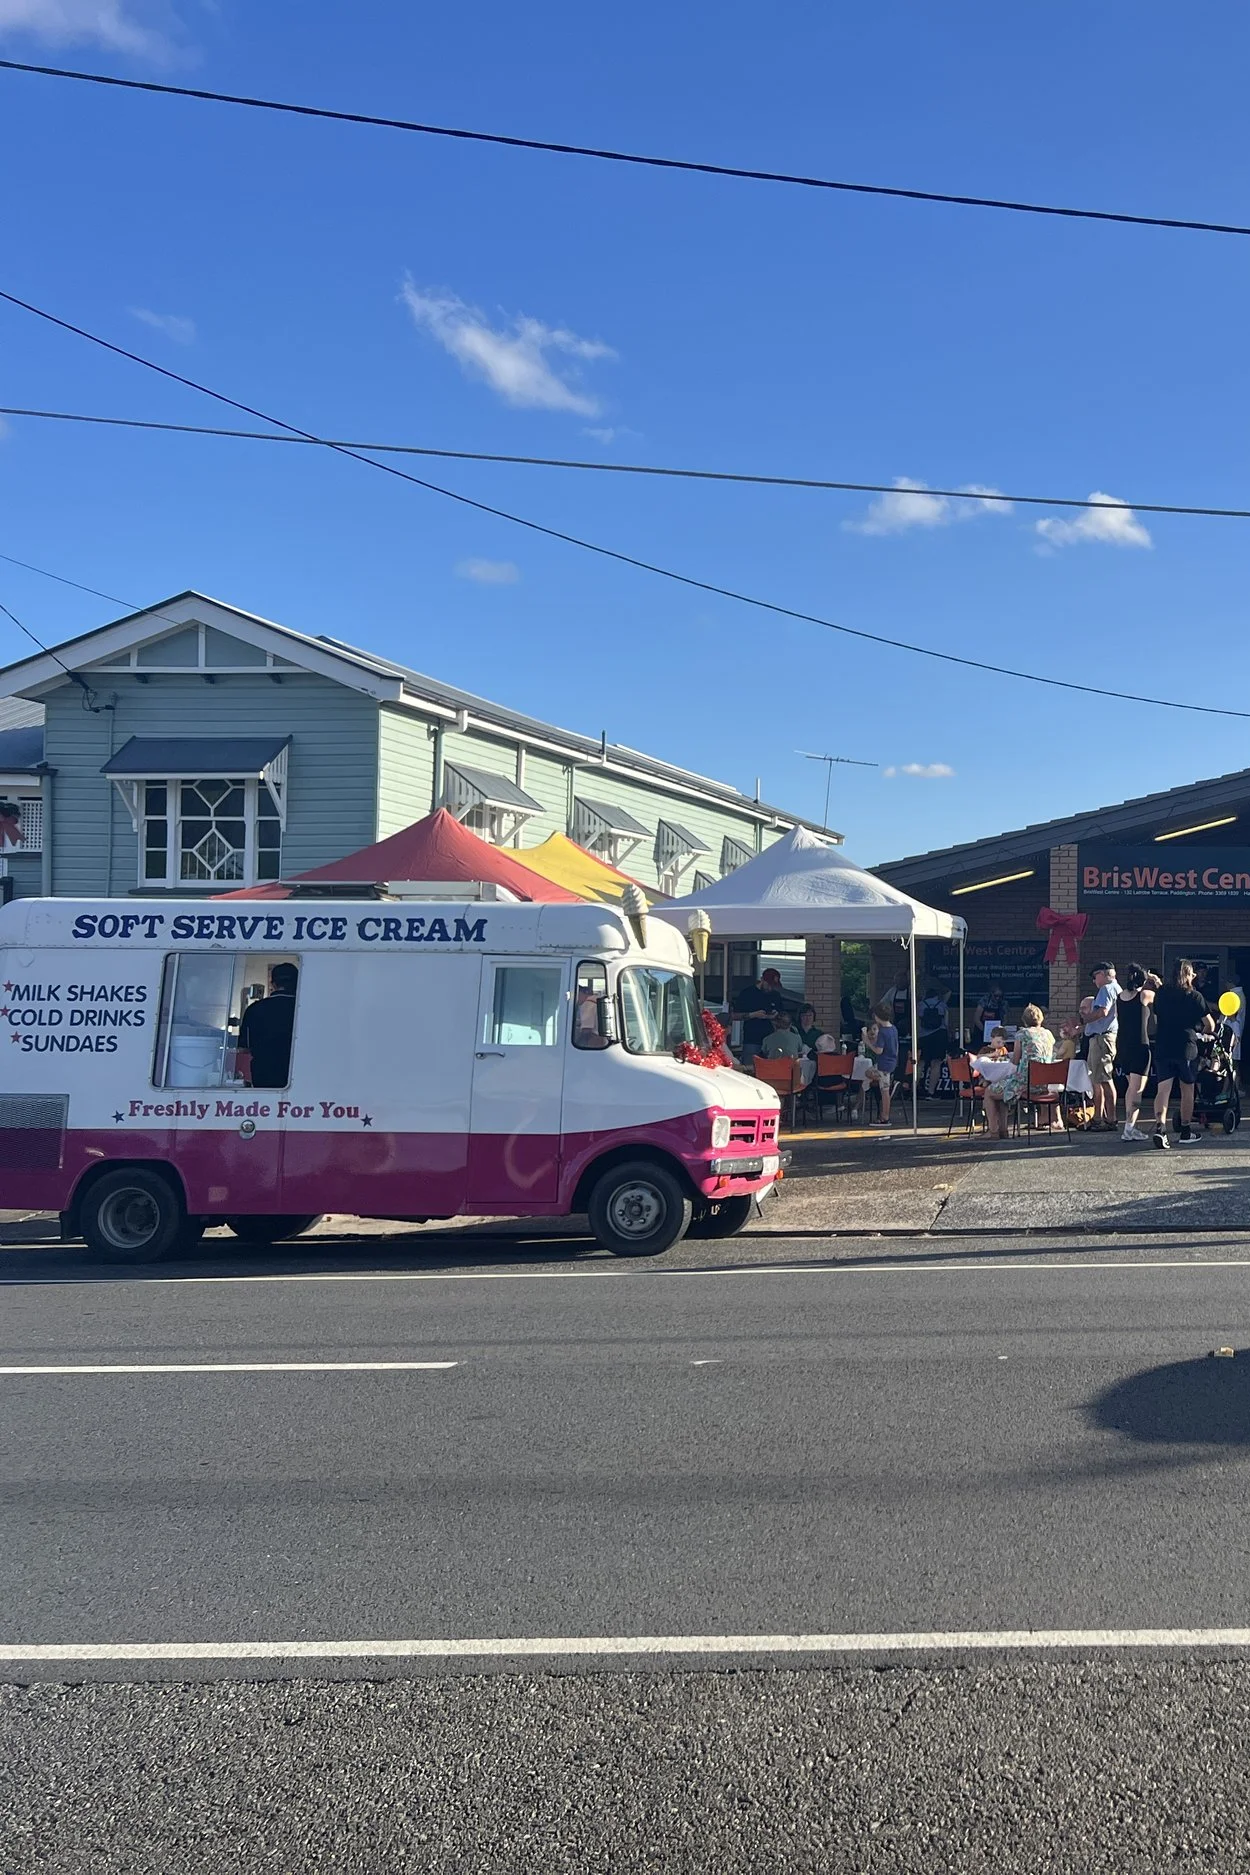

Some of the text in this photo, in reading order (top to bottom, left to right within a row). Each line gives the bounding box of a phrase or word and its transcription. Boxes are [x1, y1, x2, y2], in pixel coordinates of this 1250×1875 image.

[1083, 866, 1197, 889] BrisWest
[72, 914, 488, 943] SOFT SERVE ICE CREAM
[943, 944, 1036, 956] BriWest Centre
[11, 984, 147, 1002] MILK SHAKES
[8, 1008, 145, 1027] COLD DRINKS
[21, 1034, 118, 1053] SUNDAES
[128, 1100, 360, 1119] Freshly Made For You
